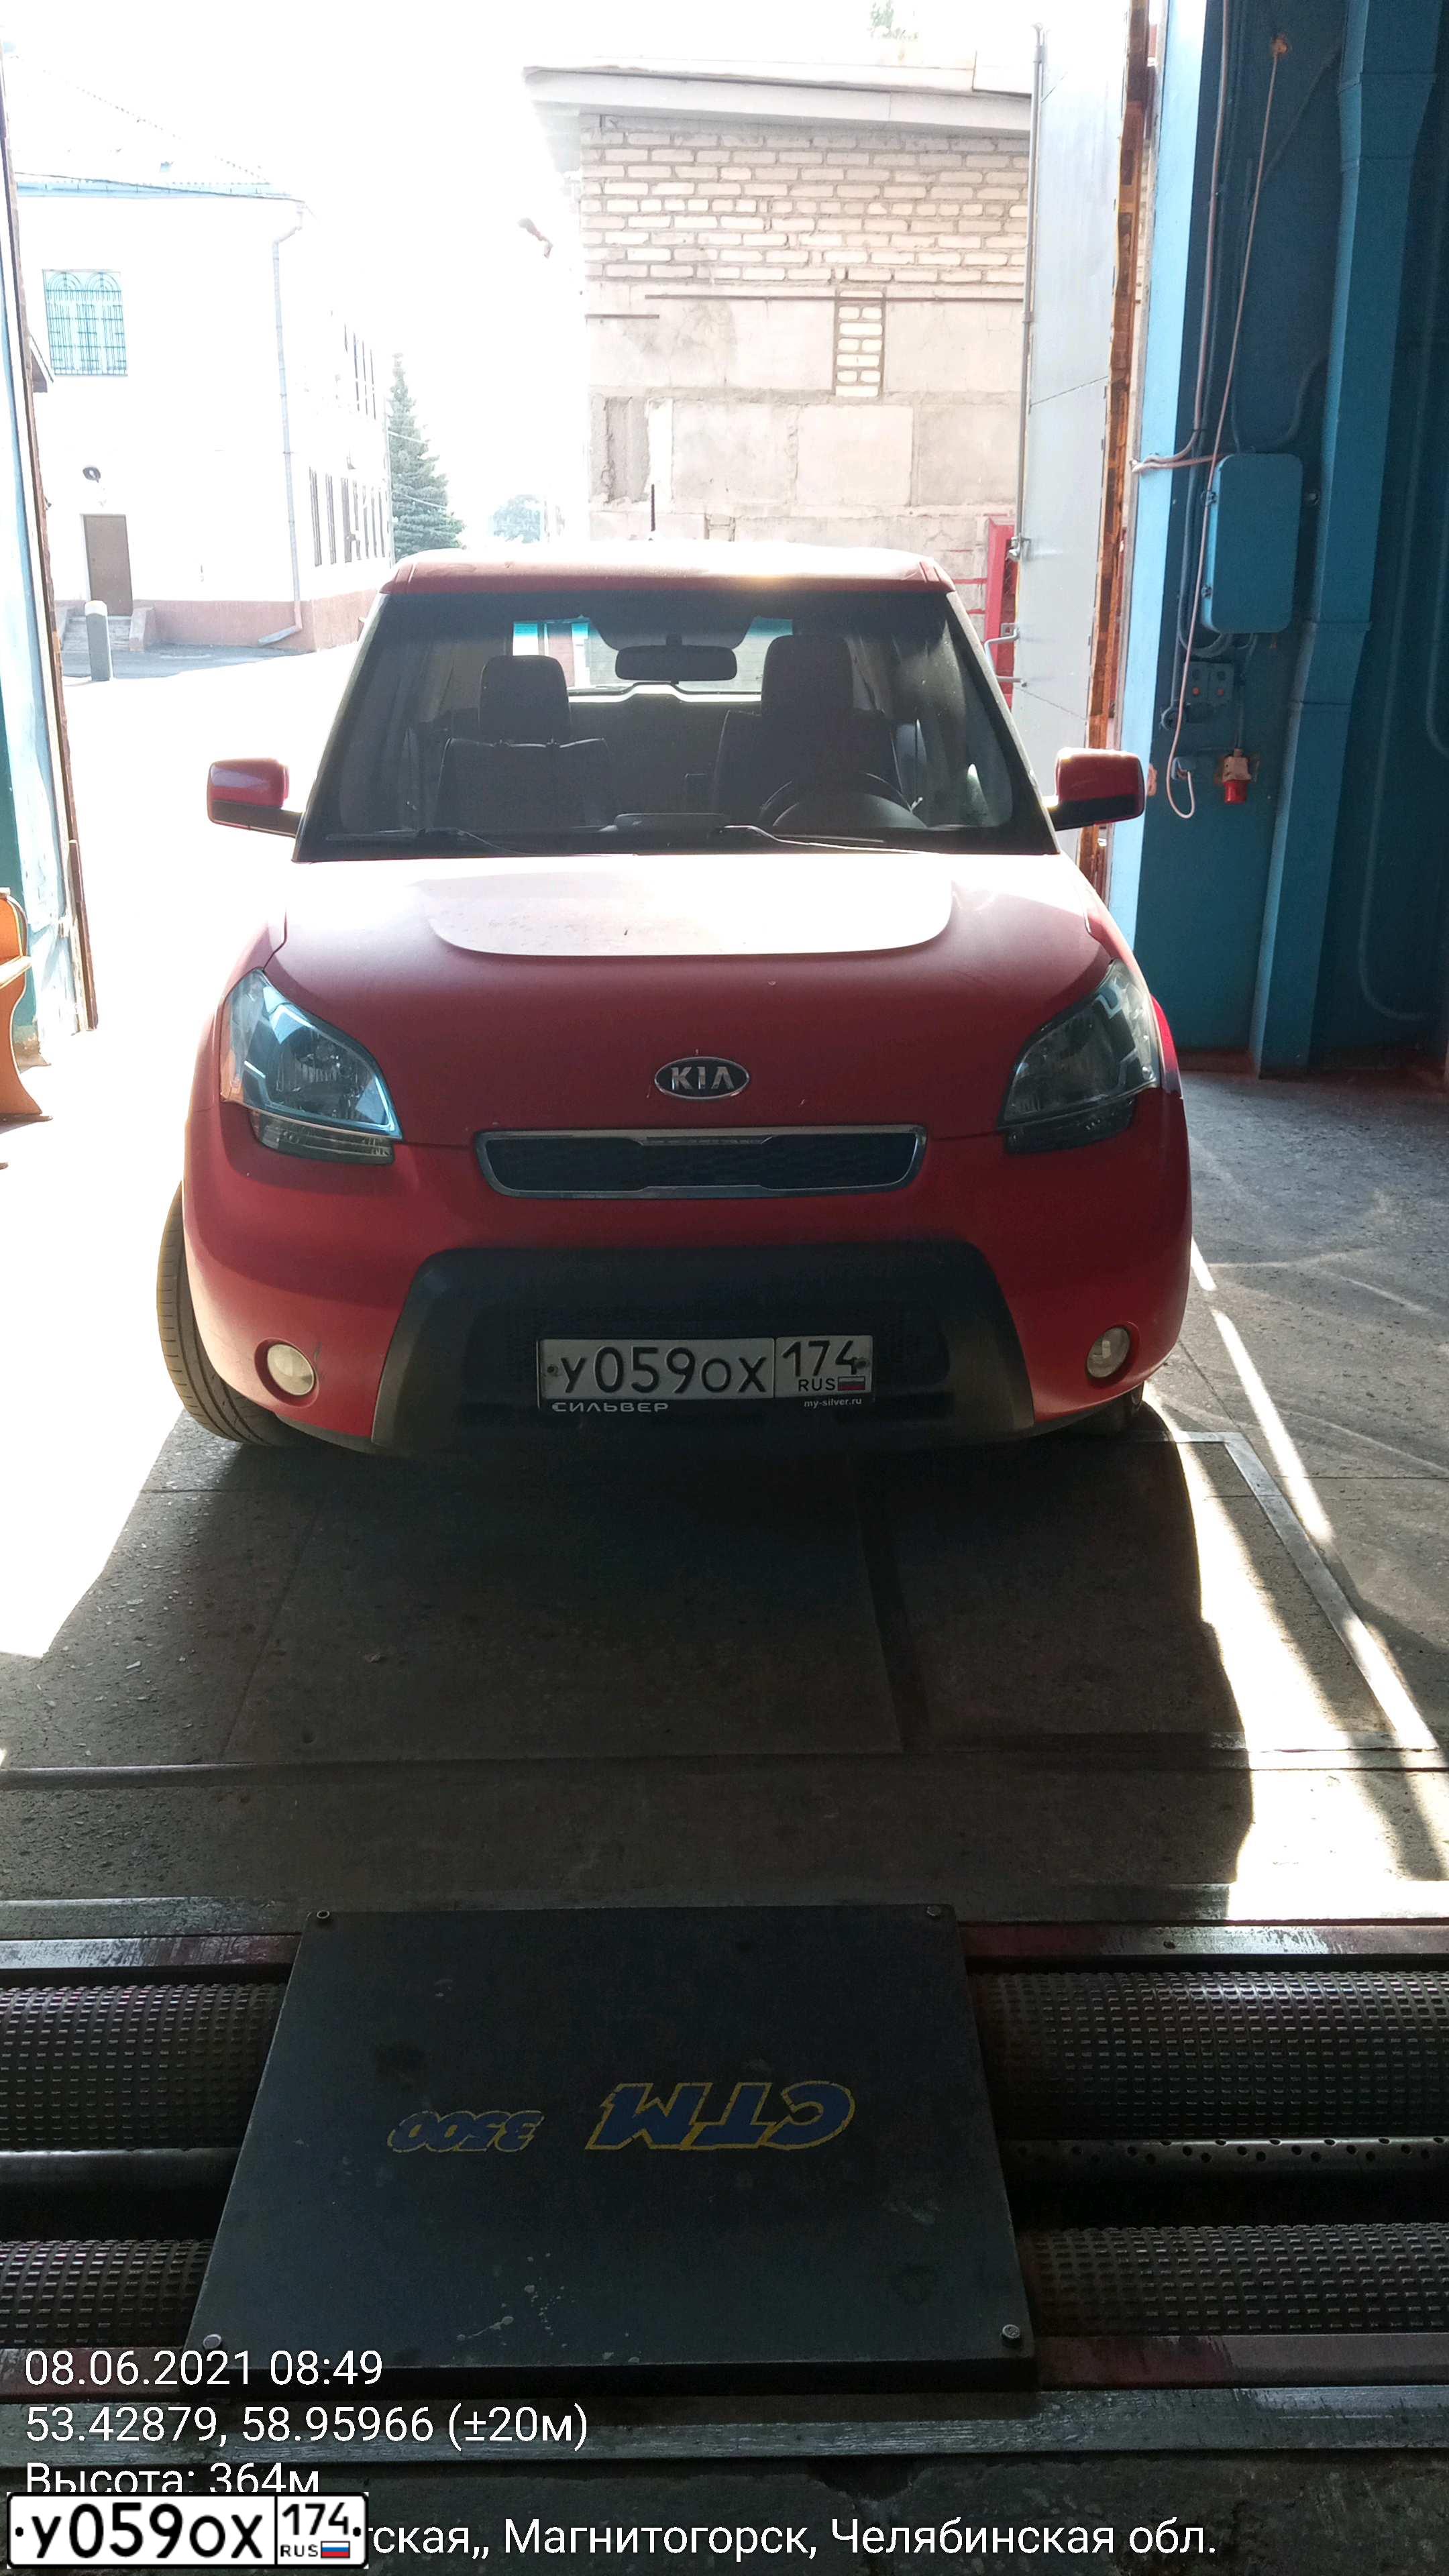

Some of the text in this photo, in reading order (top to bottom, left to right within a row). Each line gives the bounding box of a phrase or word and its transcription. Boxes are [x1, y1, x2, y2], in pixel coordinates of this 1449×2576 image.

[671, 1066, 735, 1090] KIA
[782, 1340, 857, 1377] 174
[798, 1378, 836, 1392] RUS
[551, 1402, 669, 1413] СИЛЬВЕР
[804, 1398, 863, 1409] my-silver.ru
